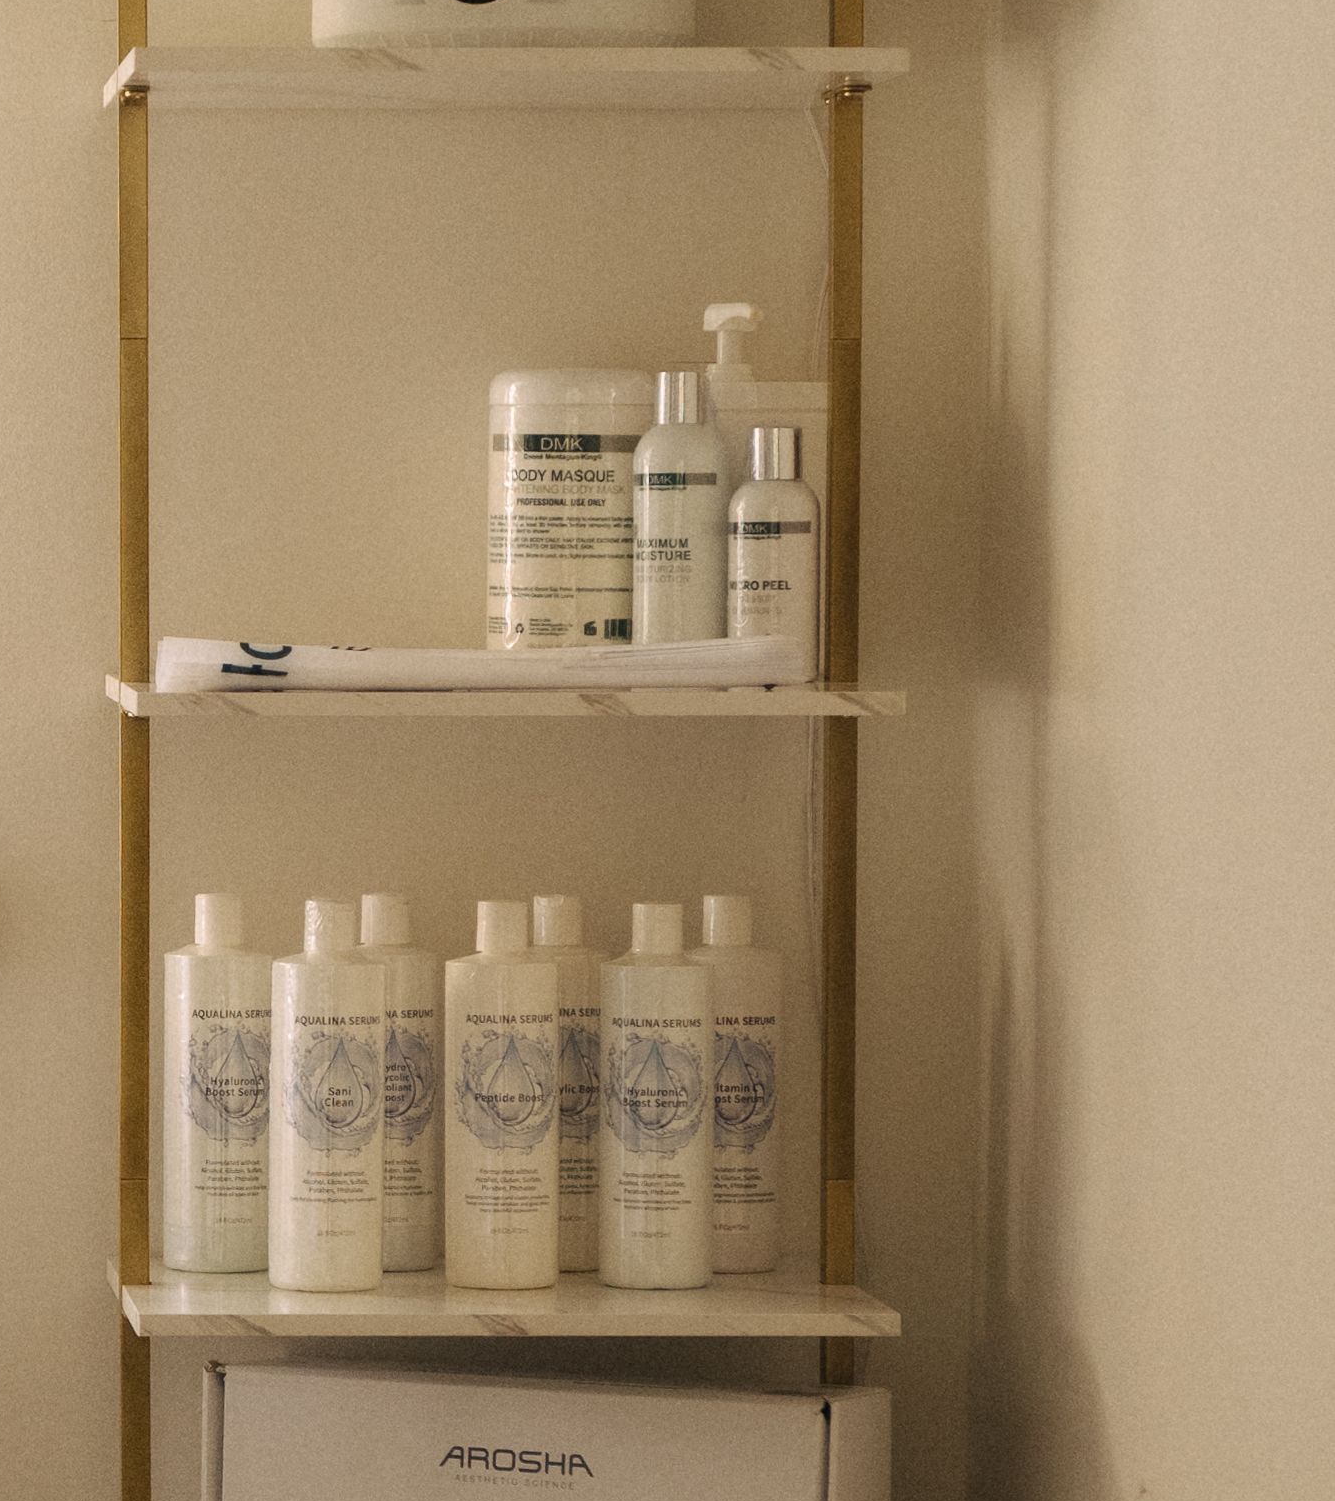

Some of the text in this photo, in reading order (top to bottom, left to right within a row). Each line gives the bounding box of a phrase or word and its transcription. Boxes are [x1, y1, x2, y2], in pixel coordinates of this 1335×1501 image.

[540, 436, 583, 451] DMK
[551, 469, 615, 483] MASQUE
[648, 475, 673, 484] DMK
[562, 485, 594, 495] BODY
[517, 498, 606, 507] PROFESSIONAL USE ONLY
[762, 579, 792, 591] PEEL
[192, 1008, 243, 1020] AQUALINA
[400, 1009, 433, 1019] SERUMS
[578, 1008, 601, 1017] SERU
[295, 1016, 381, 1026] AQUALINA SERUMS
[465, 1014, 516, 1025] AQUALINA
[519, 1013, 553, 1024] SERUMS
[611, 1017, 702, 1028] AQUALINA SERUMS
[716, 1015, 776, 1026] LINA SERUMS
[386, 1063, 407, 1074] ydro
[210, 1076, 262, 1088] Hyaluronic
[385, 1073, 410, 1083] ycolic
[205, 1086, 235, 1097] Boost
[328, 1086, 352, 1096] Sani
[385, 1083, 412, 1092] oliant
[626, 1086, 684, 1099] Hyaluronic
[715, 1083, 750, 1093] itamin
[324, 1097, 354, 1107] Clean
[385, 1094, 405, 1102] oost
[475, 1092, 544, 1105] Peptide Boost
[622, 1098, 688, 1108] Boost Serum
[714, 1094, 765, 1104] ost Serum
[439, 1445, 595, 1478] AROSHA
[455, 1474, 575, 1490] AESTHETIC SCIENCE
